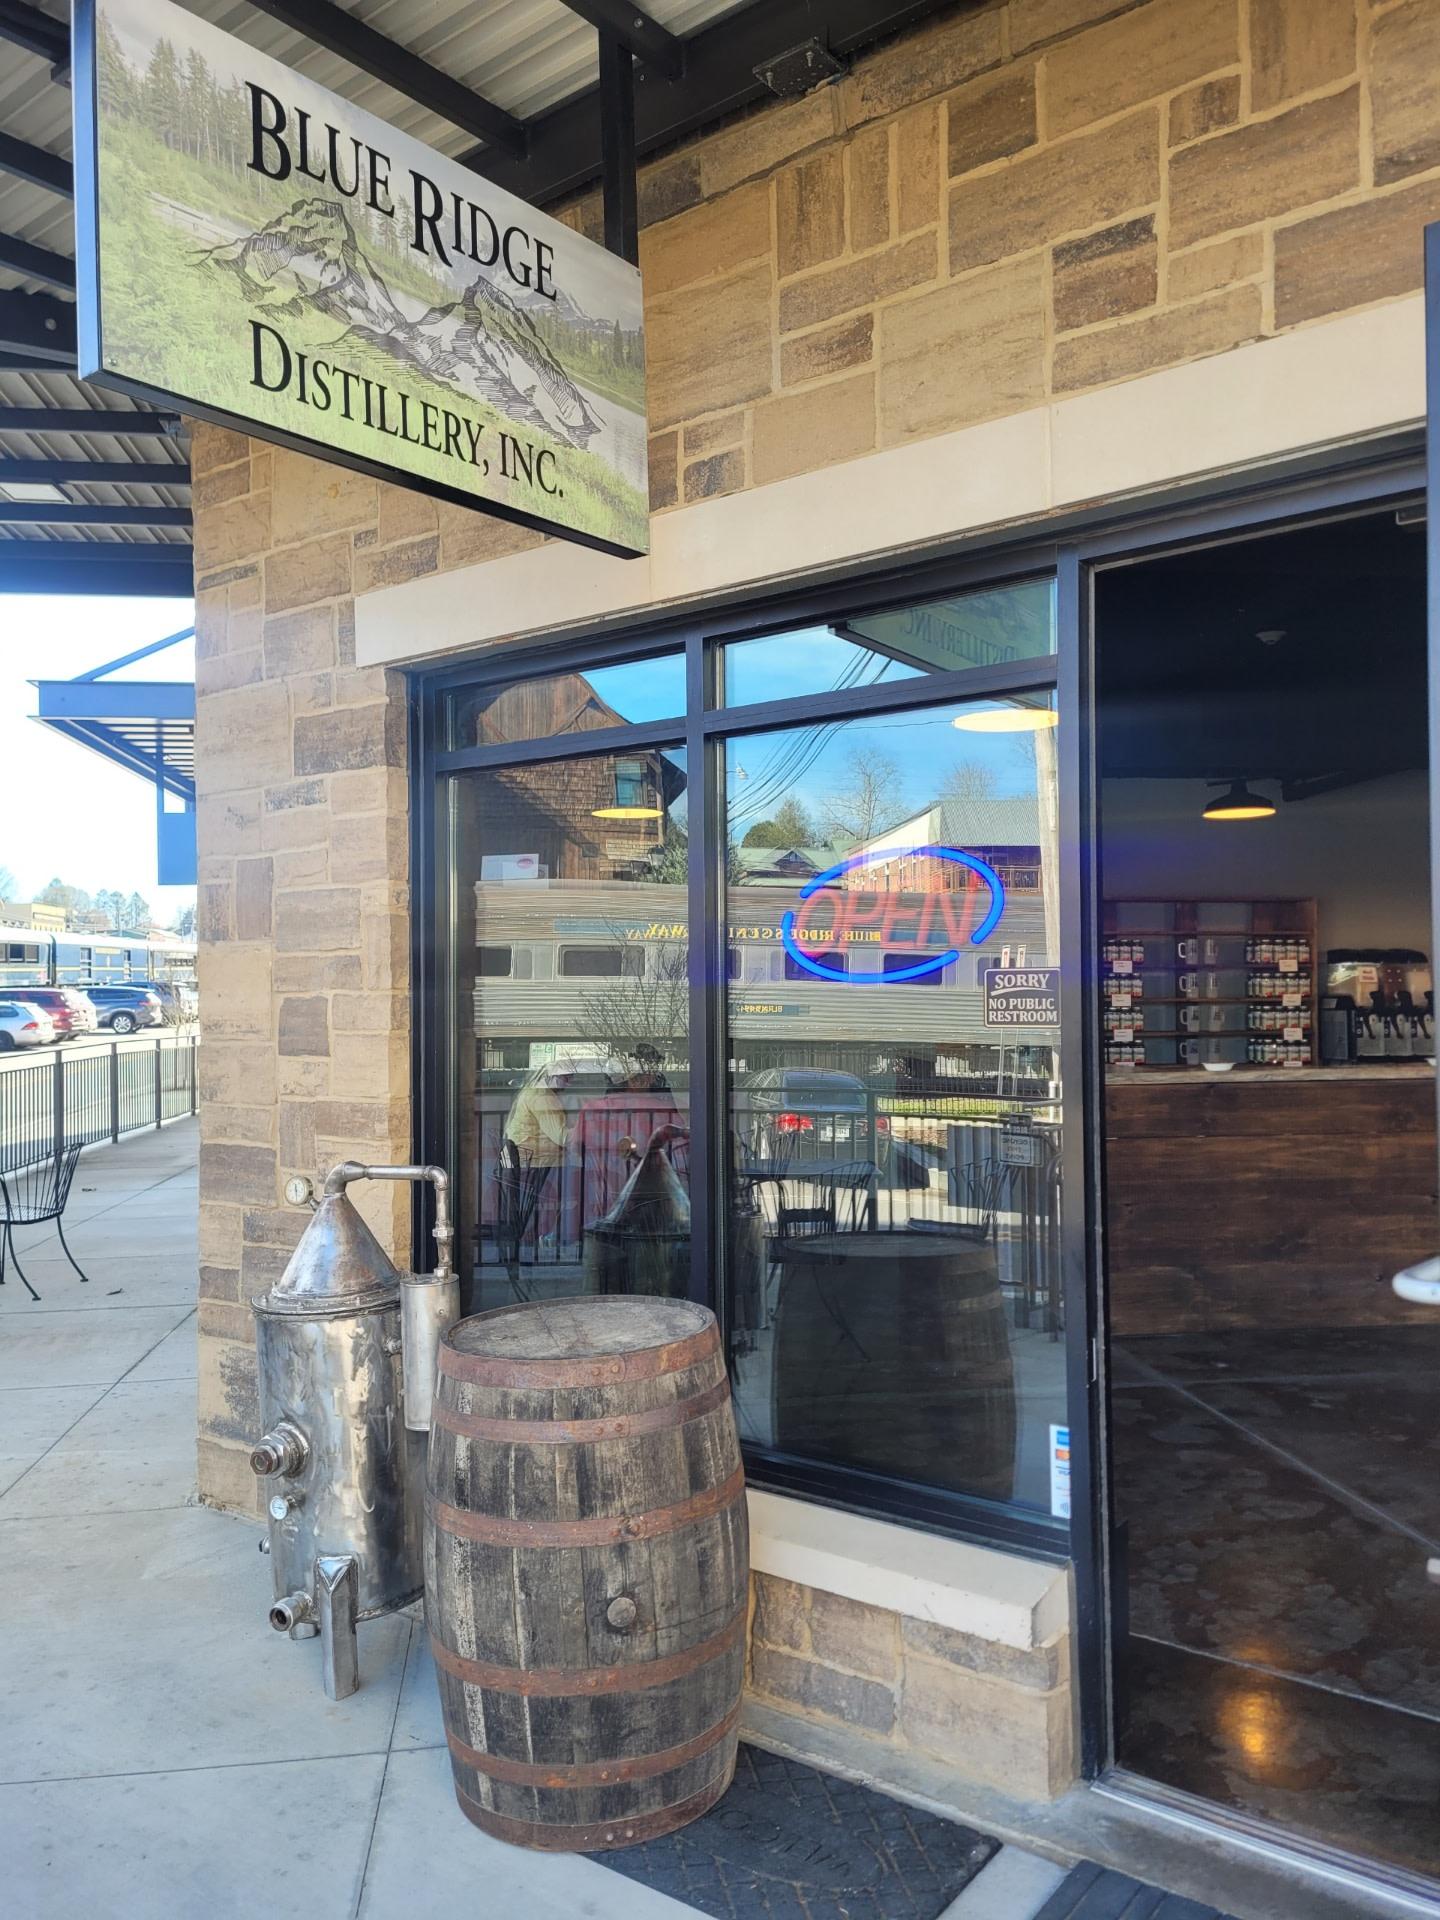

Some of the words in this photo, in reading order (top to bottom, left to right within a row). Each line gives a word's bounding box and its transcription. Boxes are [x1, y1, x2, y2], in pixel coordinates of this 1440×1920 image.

[245, 80, 395, 219] BLUE
[408, 168, 559, 300] RIDGE
[248, 319, 491, 478] DISTILLERY,
[498, 433, 565, 499] INC.
[796, 868, 983, 958] OPEN
[989, 999, 1006, 1009] NO
[1009, 999, 1054, 1009] PUBLIC
[995, 974, 1049, 988] SORRY
[989, 1011, 1057, 1022] RESTROOM
